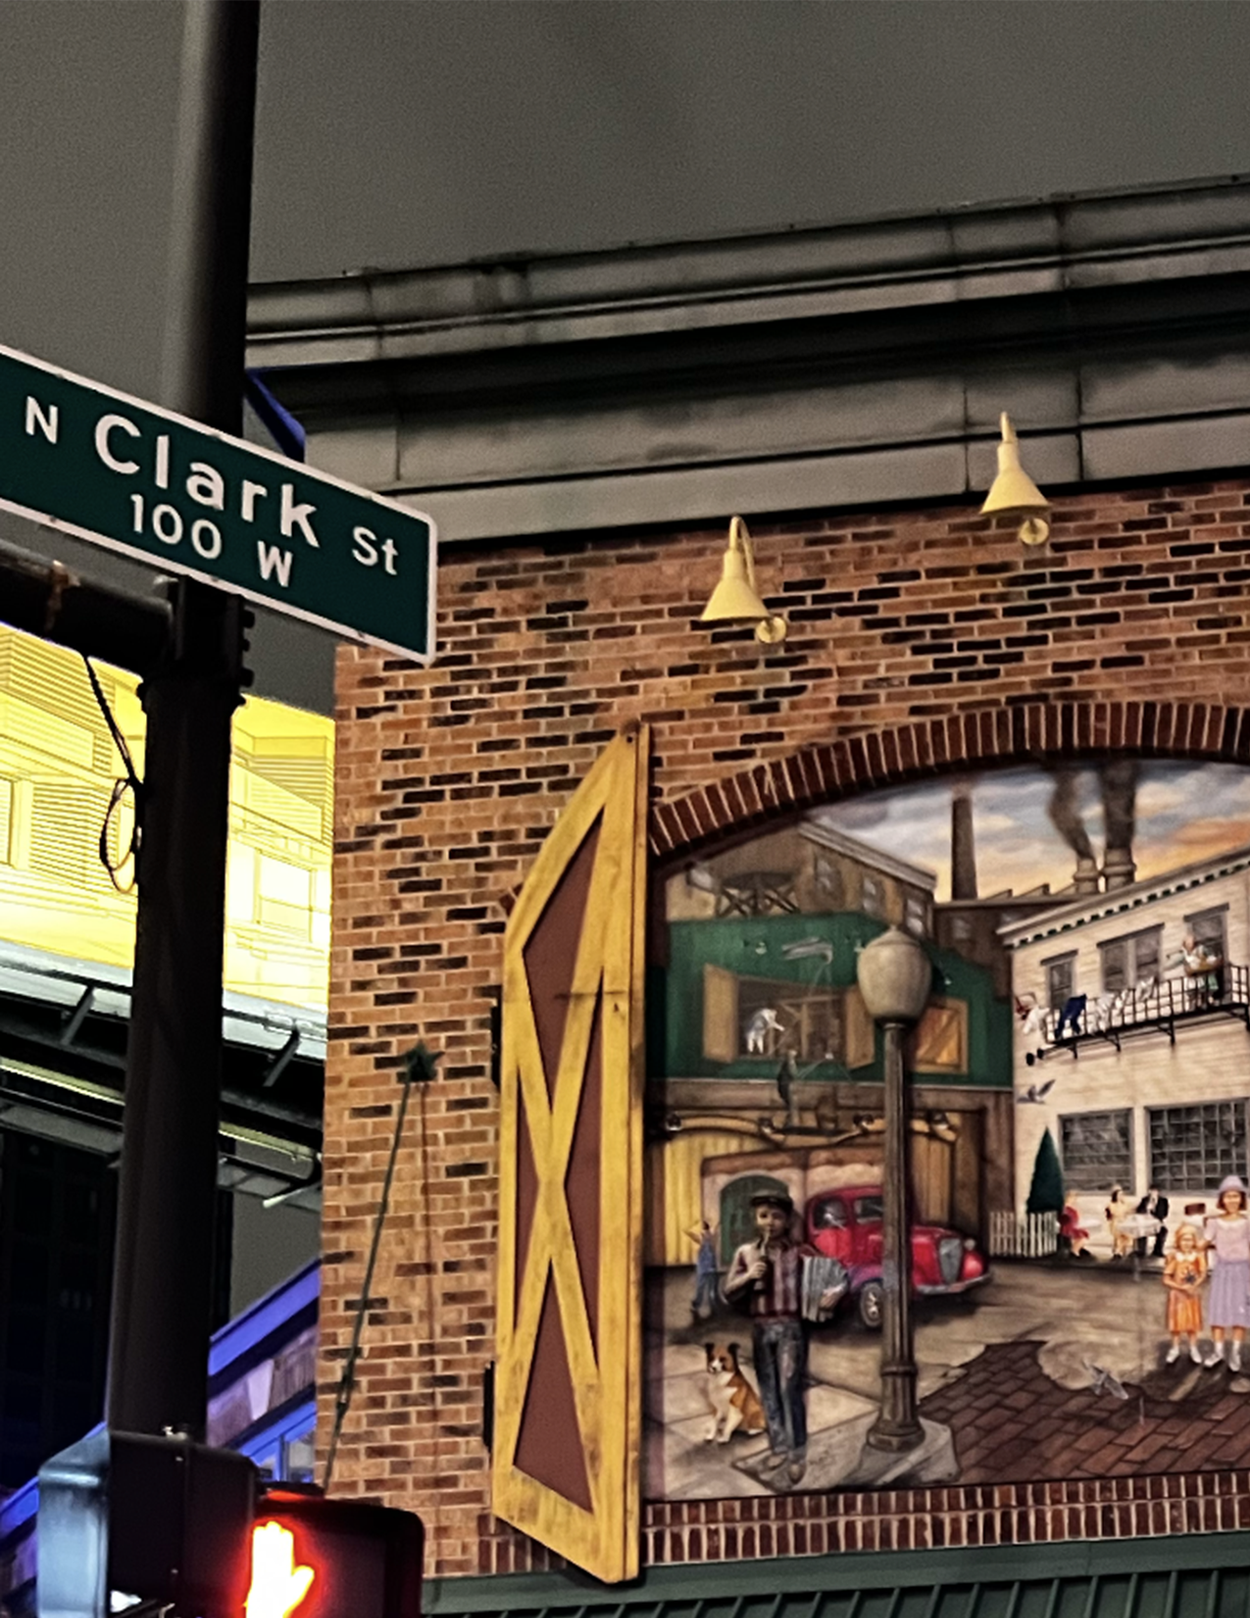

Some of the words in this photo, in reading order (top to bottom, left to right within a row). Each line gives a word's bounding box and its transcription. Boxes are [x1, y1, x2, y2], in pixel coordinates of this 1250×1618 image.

[26, 396, 58, 444] N
[95, 413, 320, 548] Clark
[352, 525, 398, 575] St
[131, 494, 222, 559] 100
[257, 540, 293, 587] W
